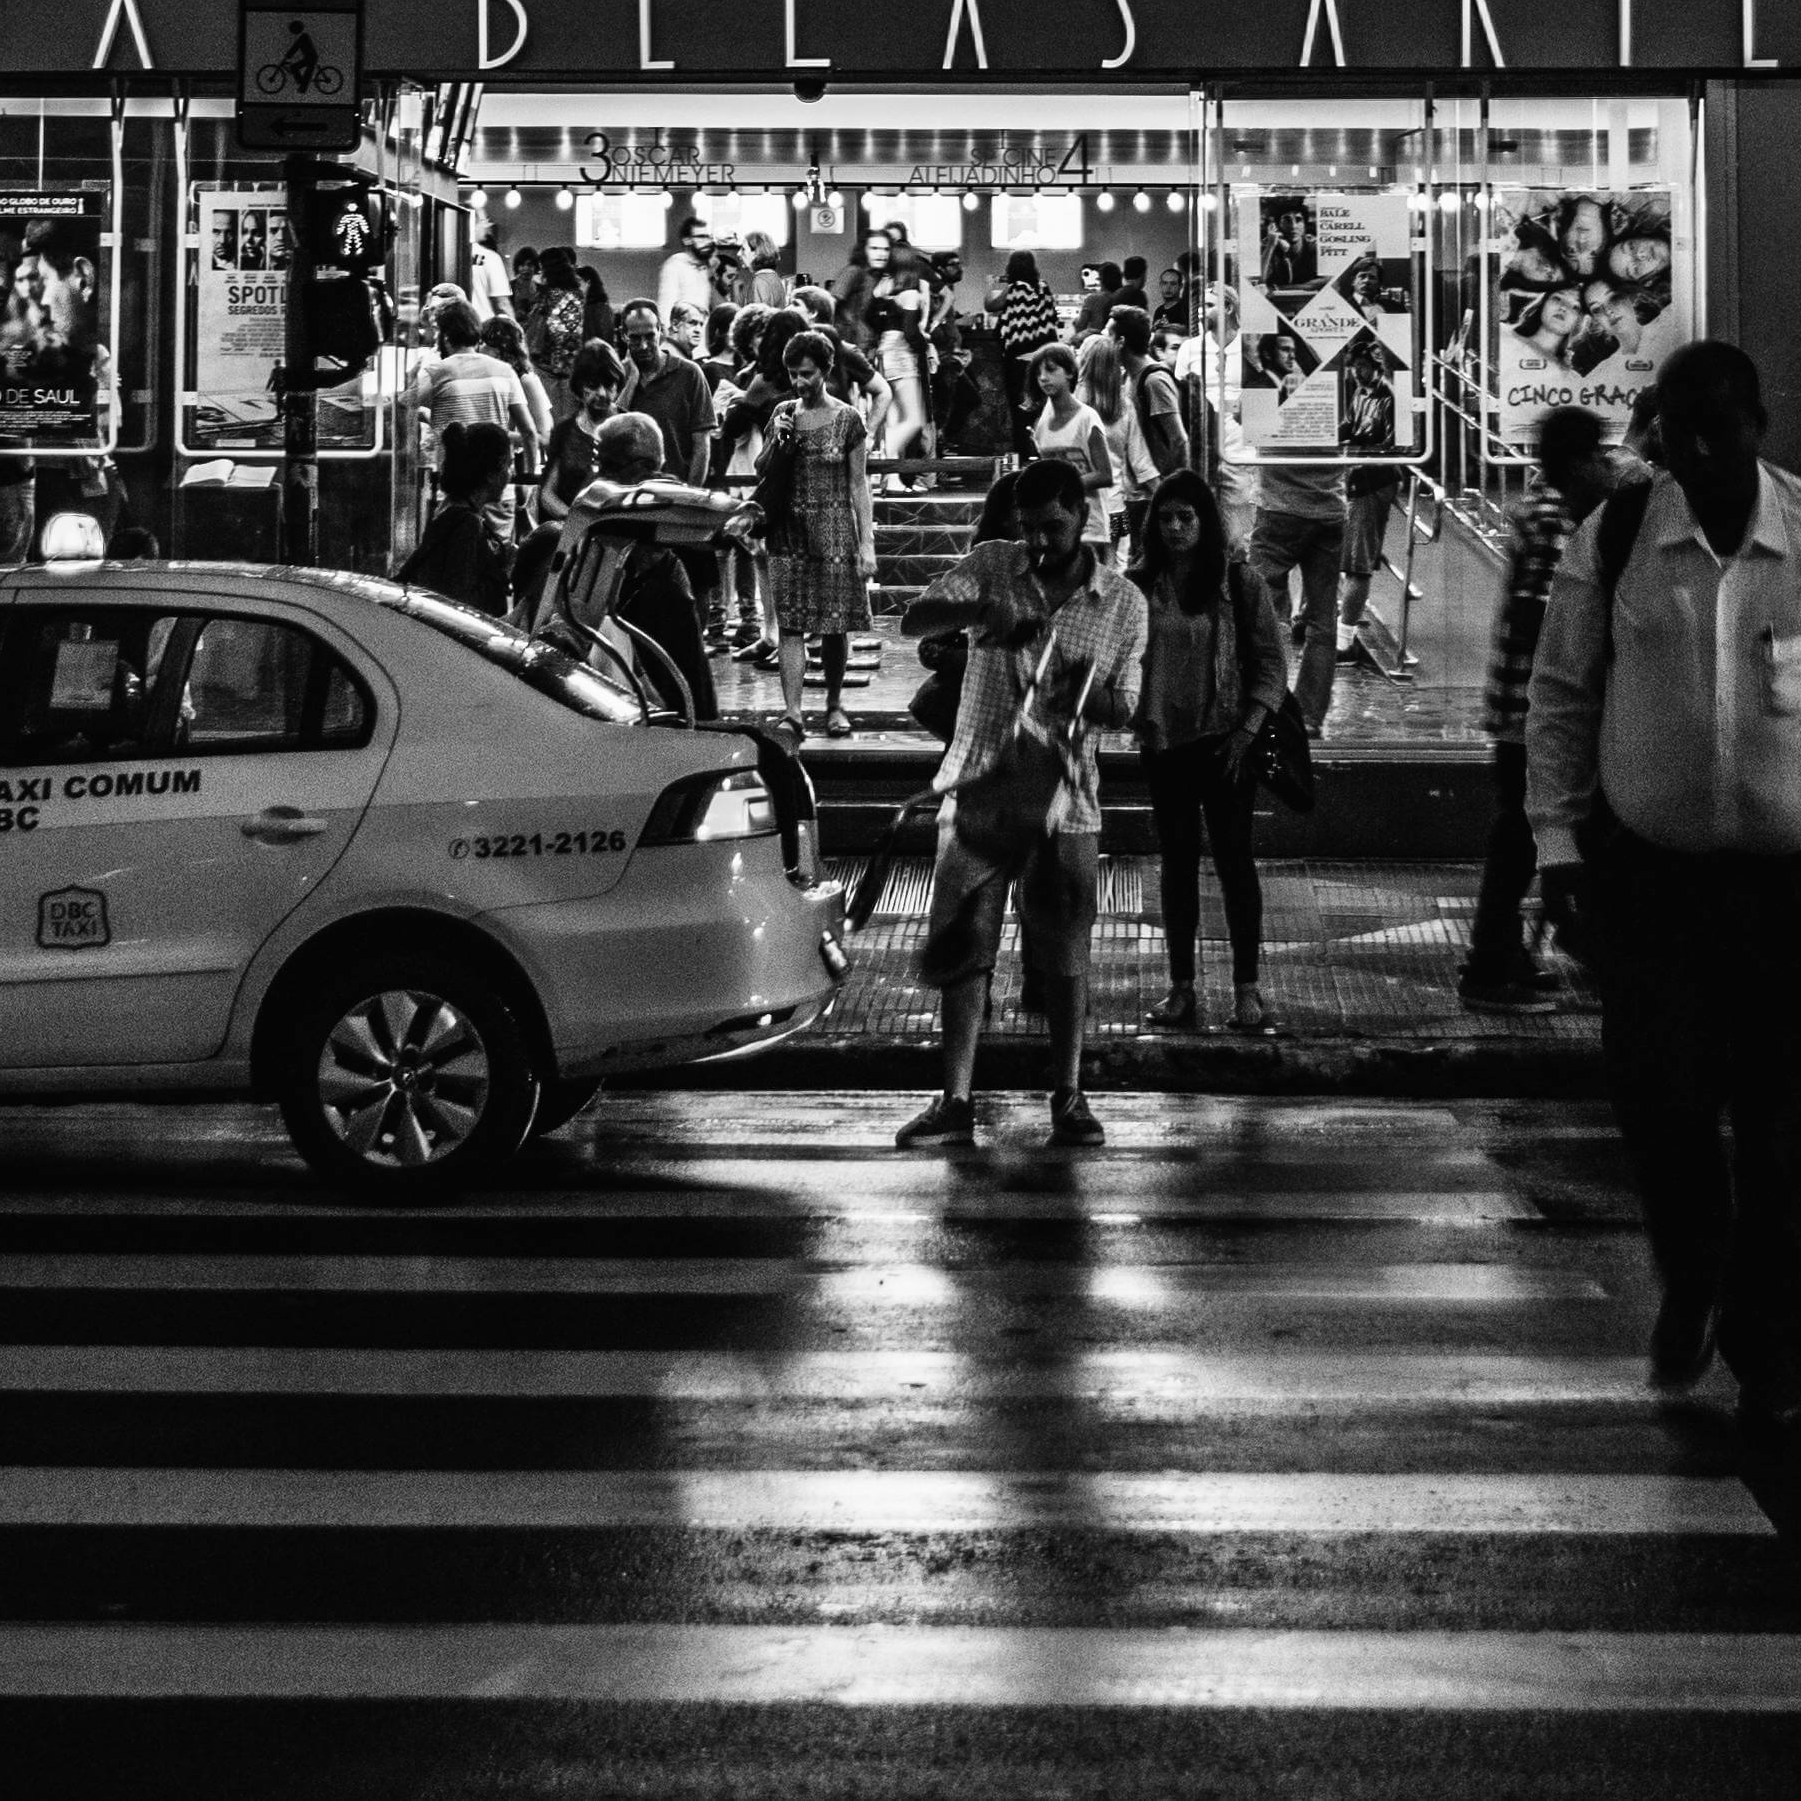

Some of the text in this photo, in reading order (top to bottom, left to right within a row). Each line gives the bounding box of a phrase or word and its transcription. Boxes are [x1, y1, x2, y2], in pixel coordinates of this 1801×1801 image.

[580, 133, 700, 183] 3 OSCAR
[909, 133, 1094, 185] ALEIJADINHO 4
[612, 164, 735, 183] NIEMEYER
[1319, 209, 1351, 218] BALE
[1319, 222, 1365, 231] CARELL
[1319, 235, 1371, 243] GOSLING
[1319, 247, 1348, 257] PITT
[227, 285, 286, 305] SPOTL
[227, 305, 278, 315] SEGREDOS
[1293, 317, 1361, 328] GRANDE
[6, 388, 30, 404] DE
[33, 388, 81, 404] SAUL
[1507, 383, 1638, 410] CINCO GRAÇ
[63, 769, 201, 799] COMUM
[473, 829, 626, 859] 3221-2126
[51, 901, 96, 920] DBC
[51, 920, 97, 938] TAXI
